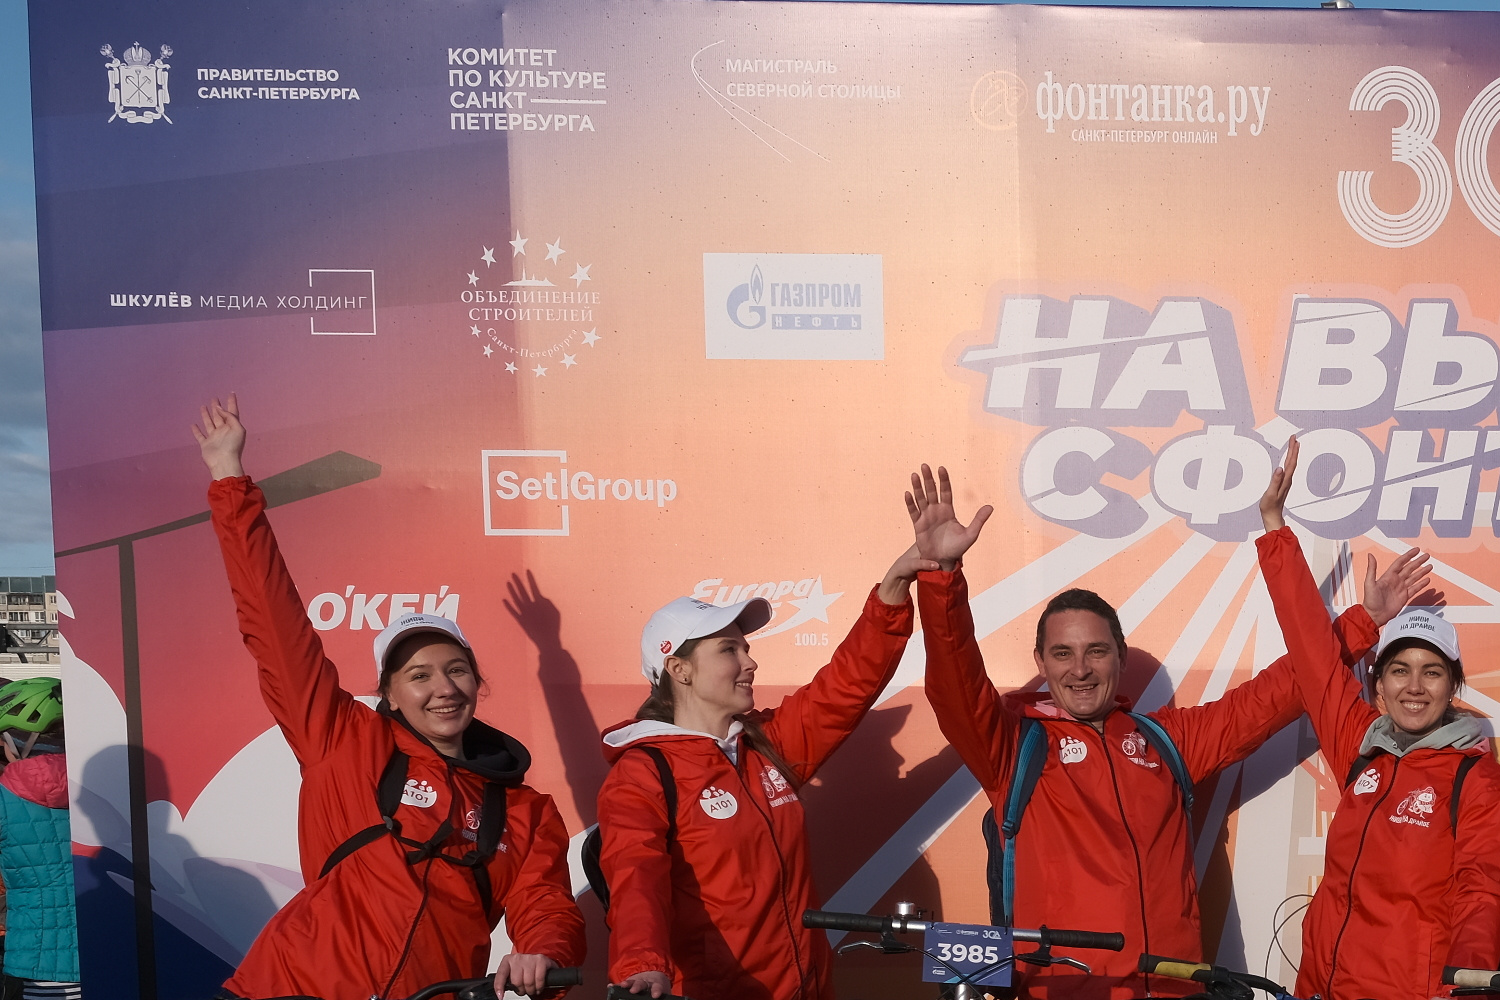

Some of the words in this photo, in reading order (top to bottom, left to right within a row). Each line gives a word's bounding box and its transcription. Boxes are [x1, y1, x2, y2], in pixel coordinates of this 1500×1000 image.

[448, 48, 557, 66] КОМИТЕТ
[725, 58, 838, 74] МАГИСТРАЛЬ
[197, 68, 339, 82] ПРАВИТЕЛЬСТВО
[449, 69, 482, 87] ПО
[489, 70, 607, 89] КУЛЬТУРЕ
[197, 87, 361, 100] САНКТ-ПЕТЕРБУРГА
[726, 81, 813, 98] СЕВЕРНОЙ
[818, 84, 901, 101] СТОЛИЦЫ
[1036, 71, 1271, 136] фонтанка.ру
[451, 113, 595, 132] ПЕТЕРБУРГА
[1071, 129, 1170, 143] САНКТ-ПЕТЕРБУРГ
[1172, 130, 1218, 144] ОНЛАЙН
[110, 291, 193, 308] ШКУЛЁВ
[200, 295, 268, 311] МЕДИА
[276, 295, 368, 311] ХОЛДИНГ
[460, 290, 601, 305] ОБЪЕДИНЕНИЕ
[770, 283, 861, 307] ГАЗПРОМ
[468, 306, 594, 322] СТРОИТЕЛЕЙ
[775, 316, 858, 327] НЕФТЬ
[487, 327, 577, 358] Санкт-Петербурга
[961, 298, 1227, 412] НА
[1020, 426, 1117, 522] С
[794, 633, 829, 647] 100.5
[937, 942, 998, 964] 3985
